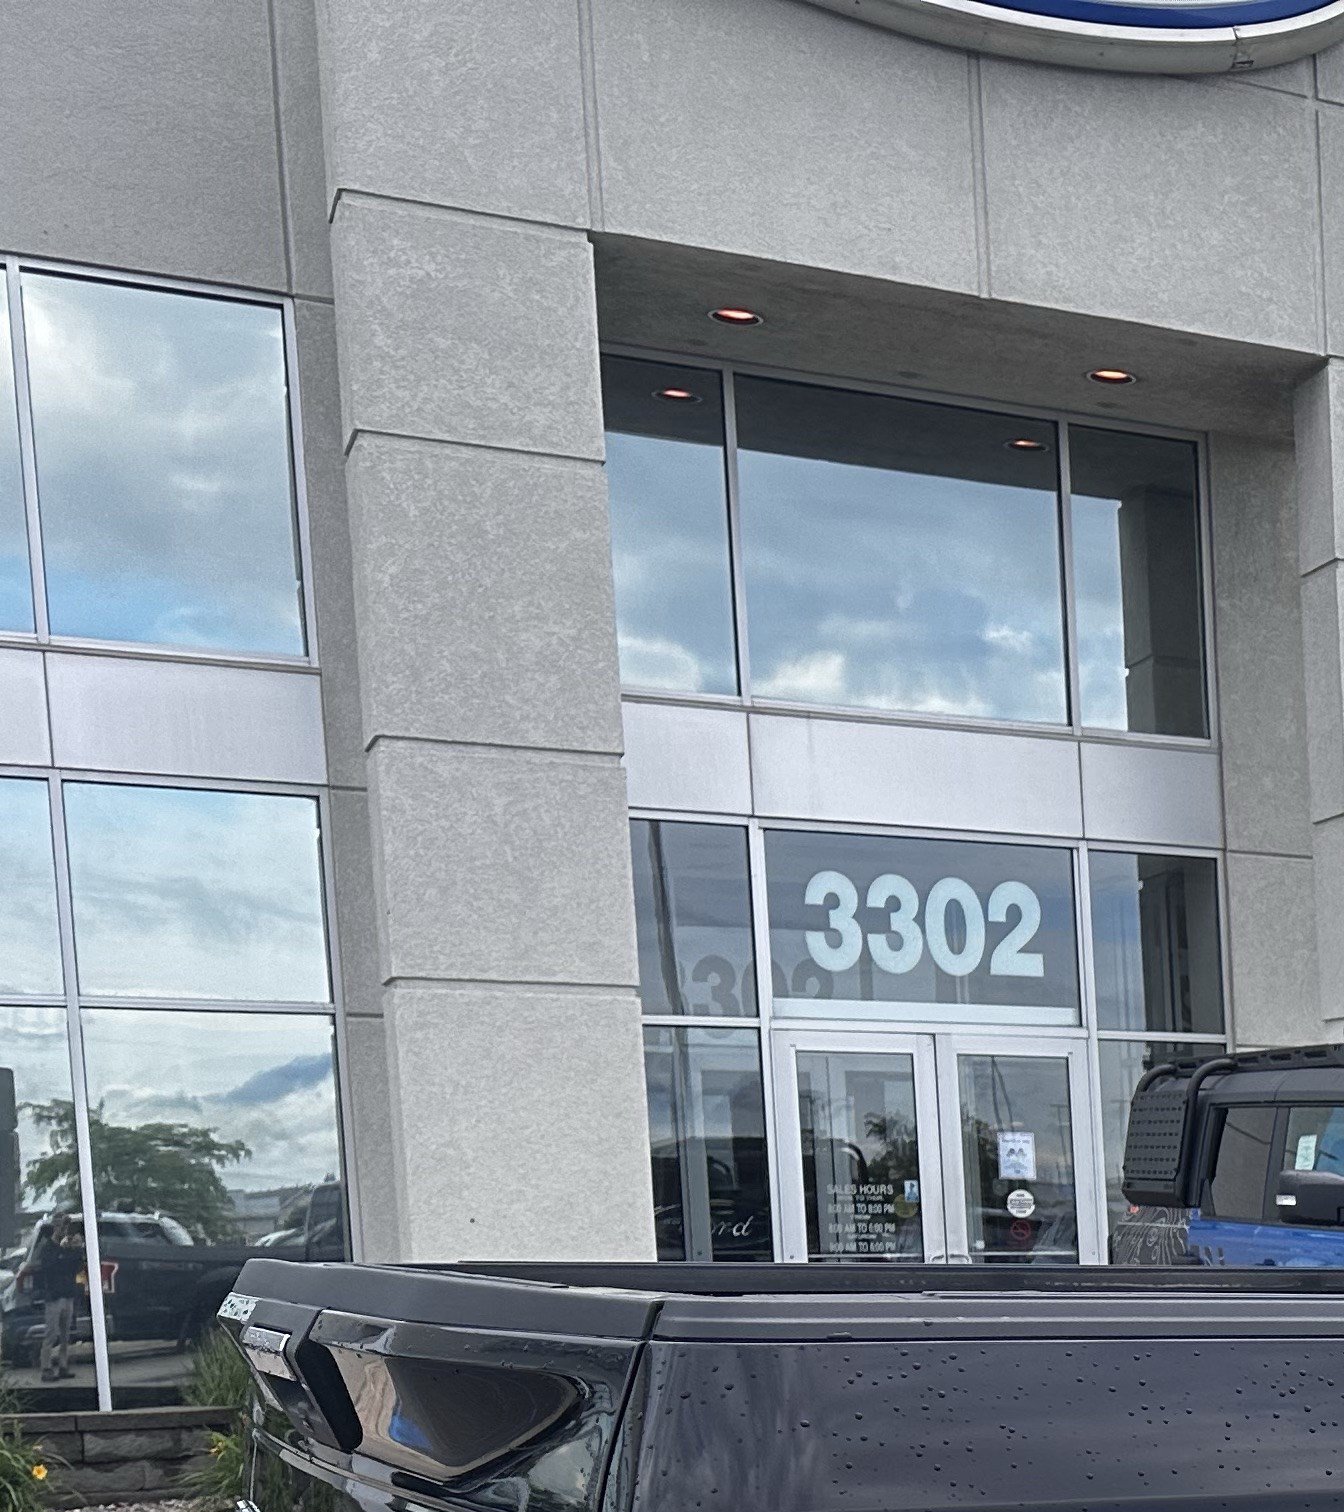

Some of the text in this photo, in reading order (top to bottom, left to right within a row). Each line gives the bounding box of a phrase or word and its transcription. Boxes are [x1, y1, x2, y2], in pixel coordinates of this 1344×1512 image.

[805, 871, 1044, 977] 3302
[826, 1183, 894, 1195] SALES HOURS
